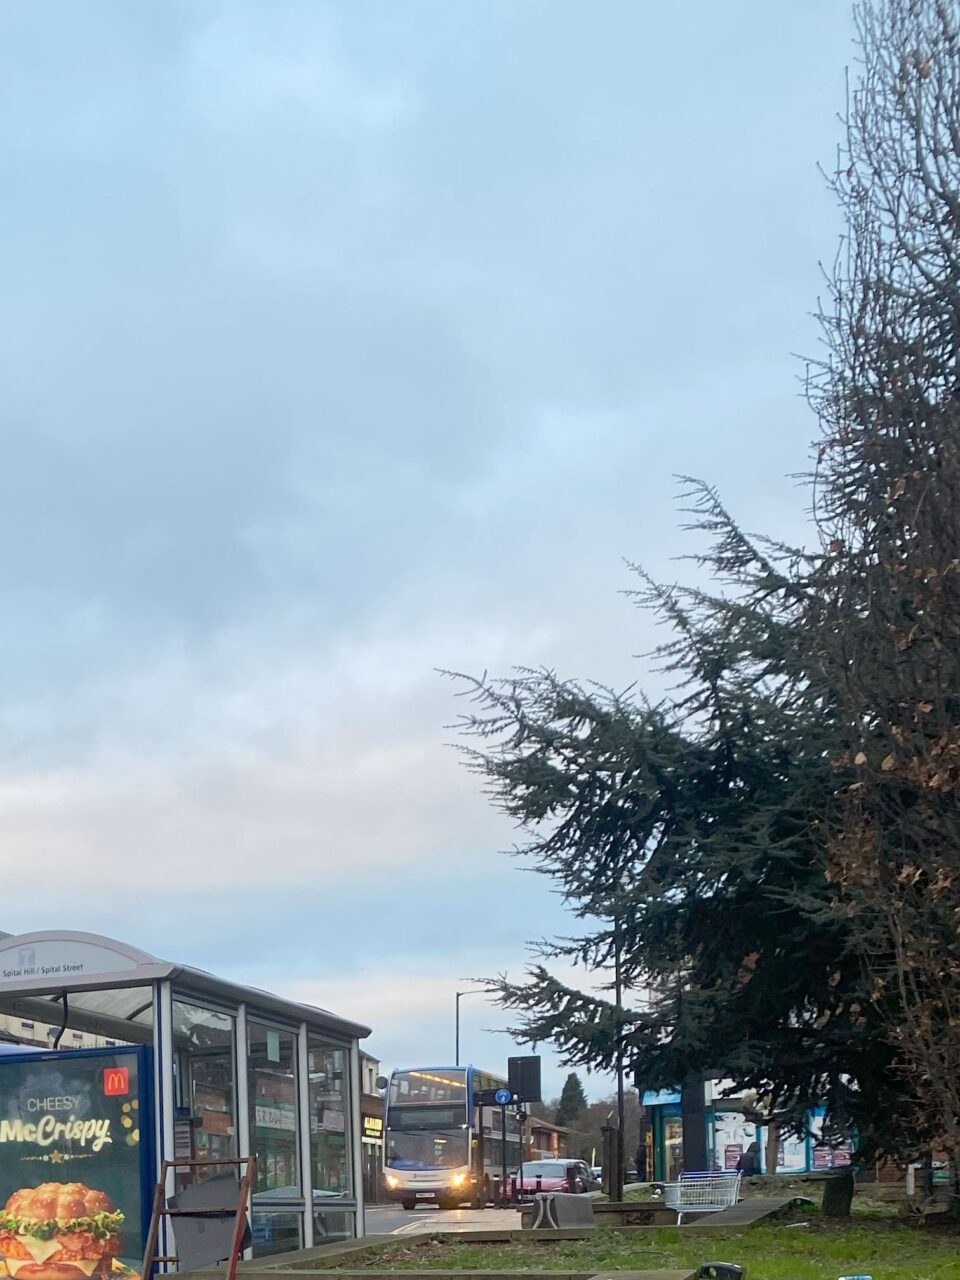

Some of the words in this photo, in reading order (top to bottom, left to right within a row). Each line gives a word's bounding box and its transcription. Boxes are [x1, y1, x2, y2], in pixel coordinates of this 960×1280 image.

[2, 969, 22, 978] Spital
[23, 967, 35, 975] Hill
[41, 966, 61, 975] Spital
[62, 963, 84, 972] Street
[27, 1095, 81, 1112] CHEESY
